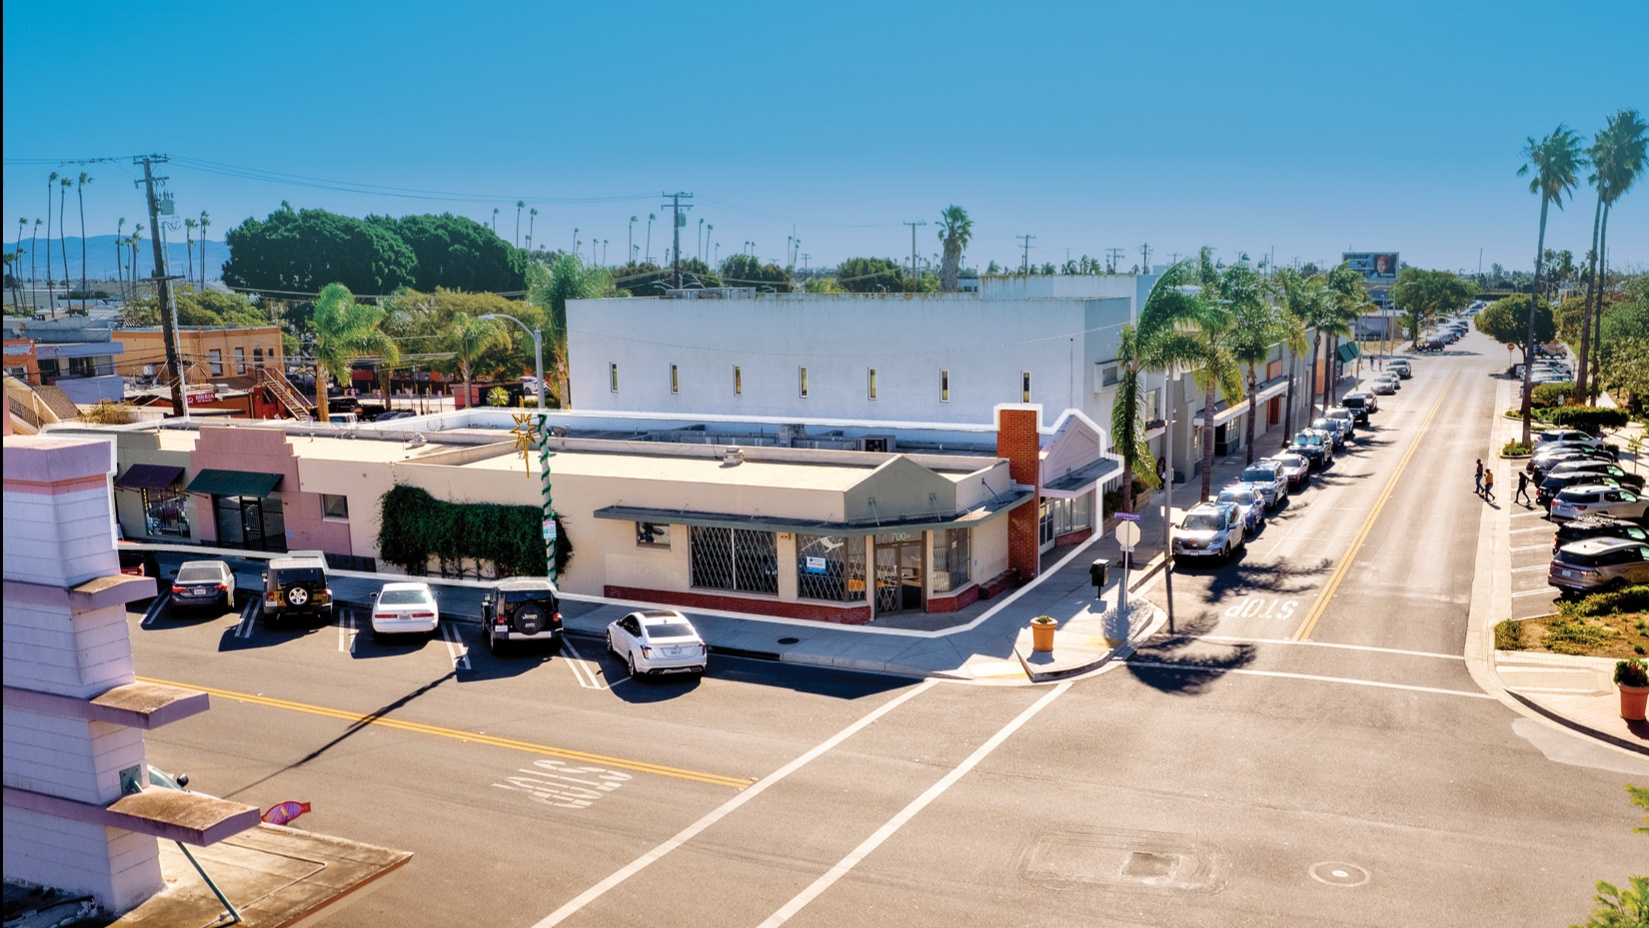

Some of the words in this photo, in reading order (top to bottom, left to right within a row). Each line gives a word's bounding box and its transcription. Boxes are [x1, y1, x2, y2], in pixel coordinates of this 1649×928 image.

[891, 532, 907, 541] 700
[1224, 597, 1299, 620] STOP
[491, 759, 633, 809] STOP
